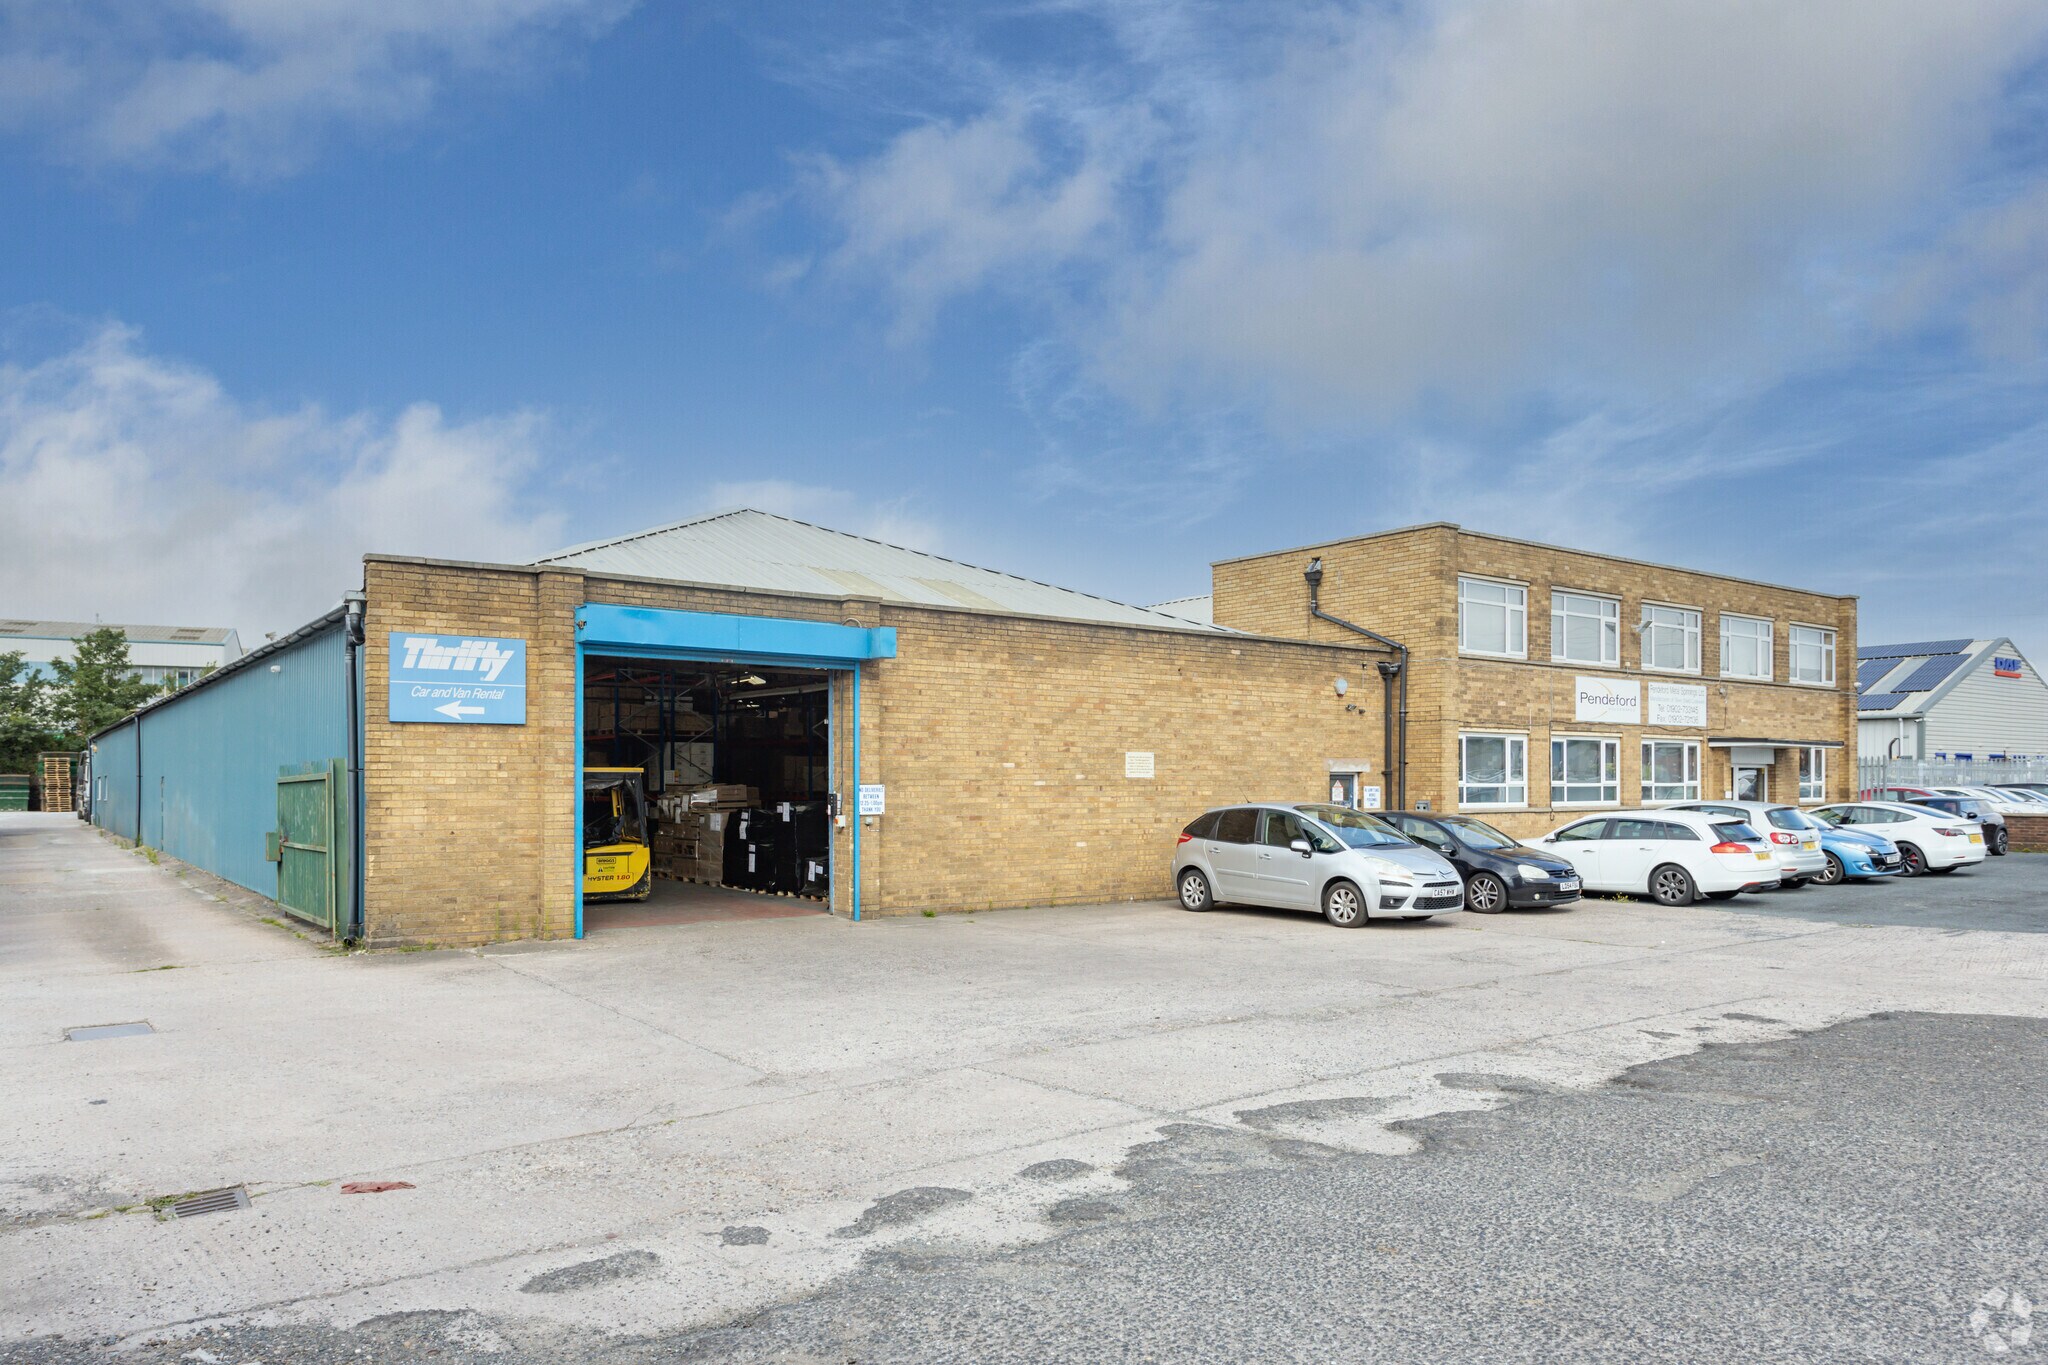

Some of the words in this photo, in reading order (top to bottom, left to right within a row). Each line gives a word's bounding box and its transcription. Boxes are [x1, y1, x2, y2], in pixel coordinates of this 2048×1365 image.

[403, 637, 515, 681] Thrifty
[1995, 657, 2022, 671] DAF
[411, 686, 431, 697] Car
[431, 687, 452, 698] and
[452, 688, 471, 699] Van
[472, 688, 505, 700] Rental
[1580, 691, 1637, 707] Pendeford
